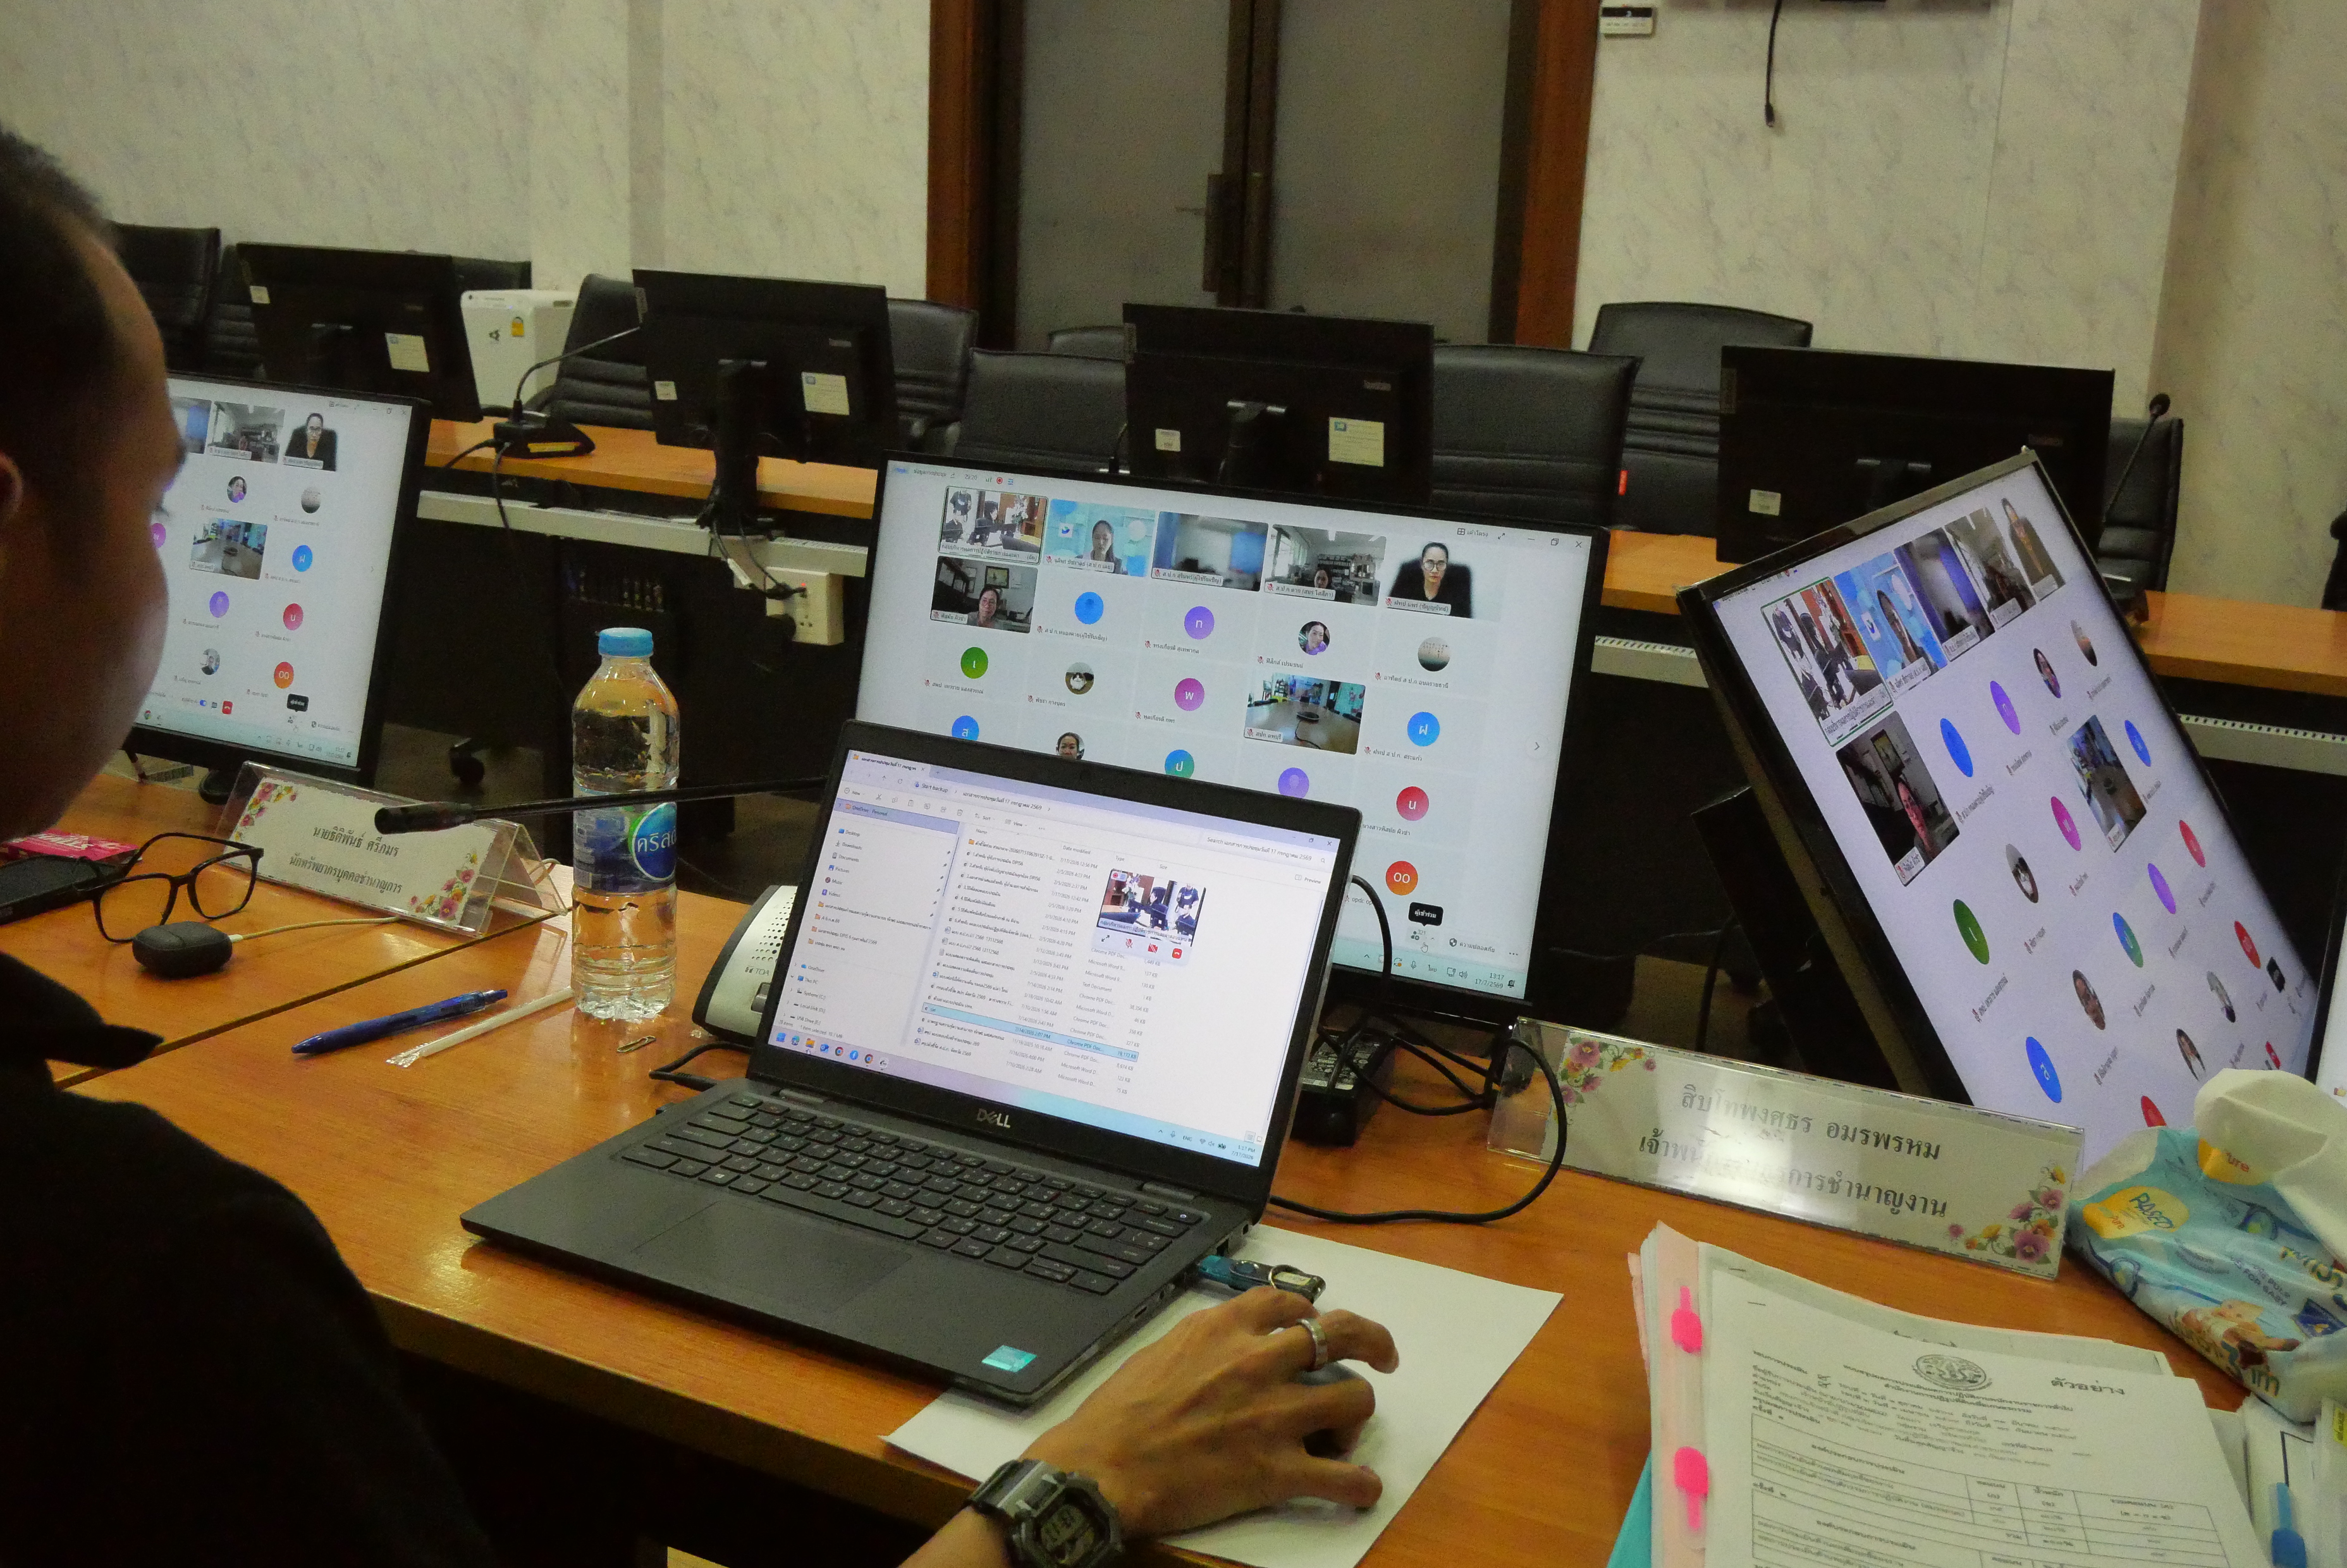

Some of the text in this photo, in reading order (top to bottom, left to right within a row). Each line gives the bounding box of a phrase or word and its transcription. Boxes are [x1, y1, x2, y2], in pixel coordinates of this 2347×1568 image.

[931, 785, 948, 793] backup
[976, 1108, 1011, 1129] DELL
[1825, 1120, 1941, 1161] อมรพรหม
[2050, 1374, 2125, 1396] ตัวอย่าง
